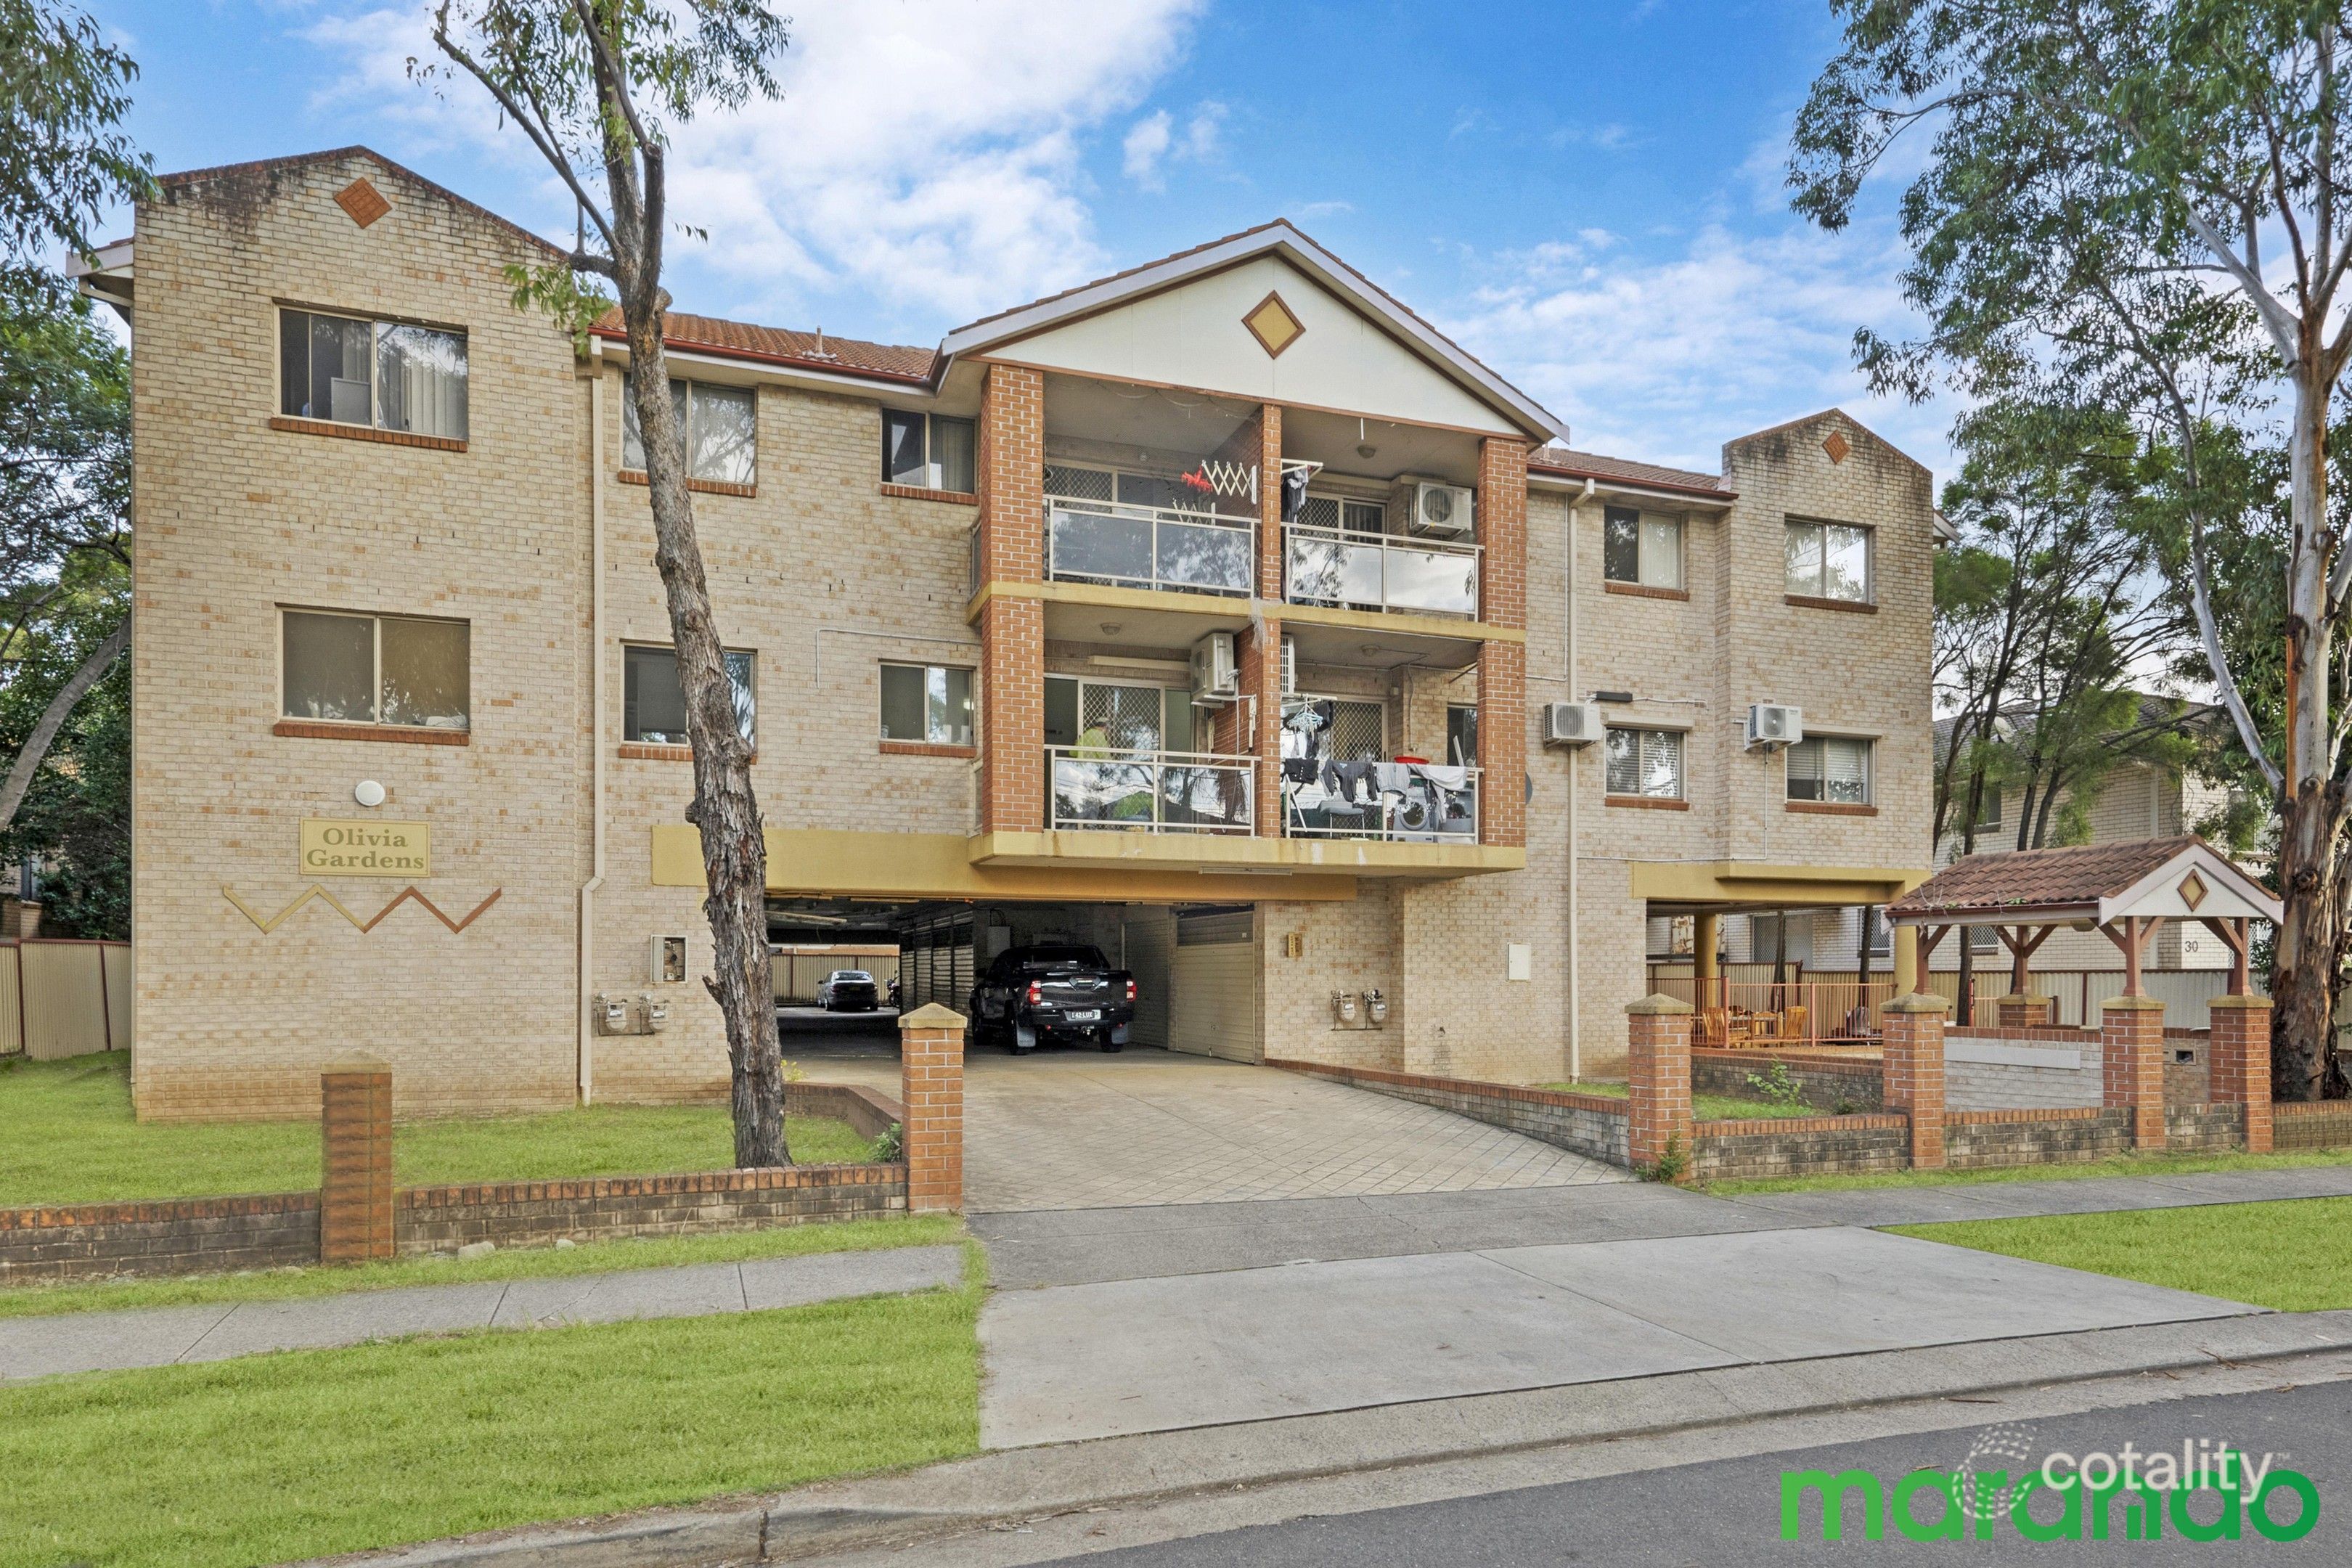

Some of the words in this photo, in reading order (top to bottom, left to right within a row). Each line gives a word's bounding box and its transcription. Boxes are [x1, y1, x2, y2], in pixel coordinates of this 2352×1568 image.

[323, 828, 408, 847] Olivia
[306, 849, 424, 869] Gardens
[2184, 941, 2199, 952] 30
